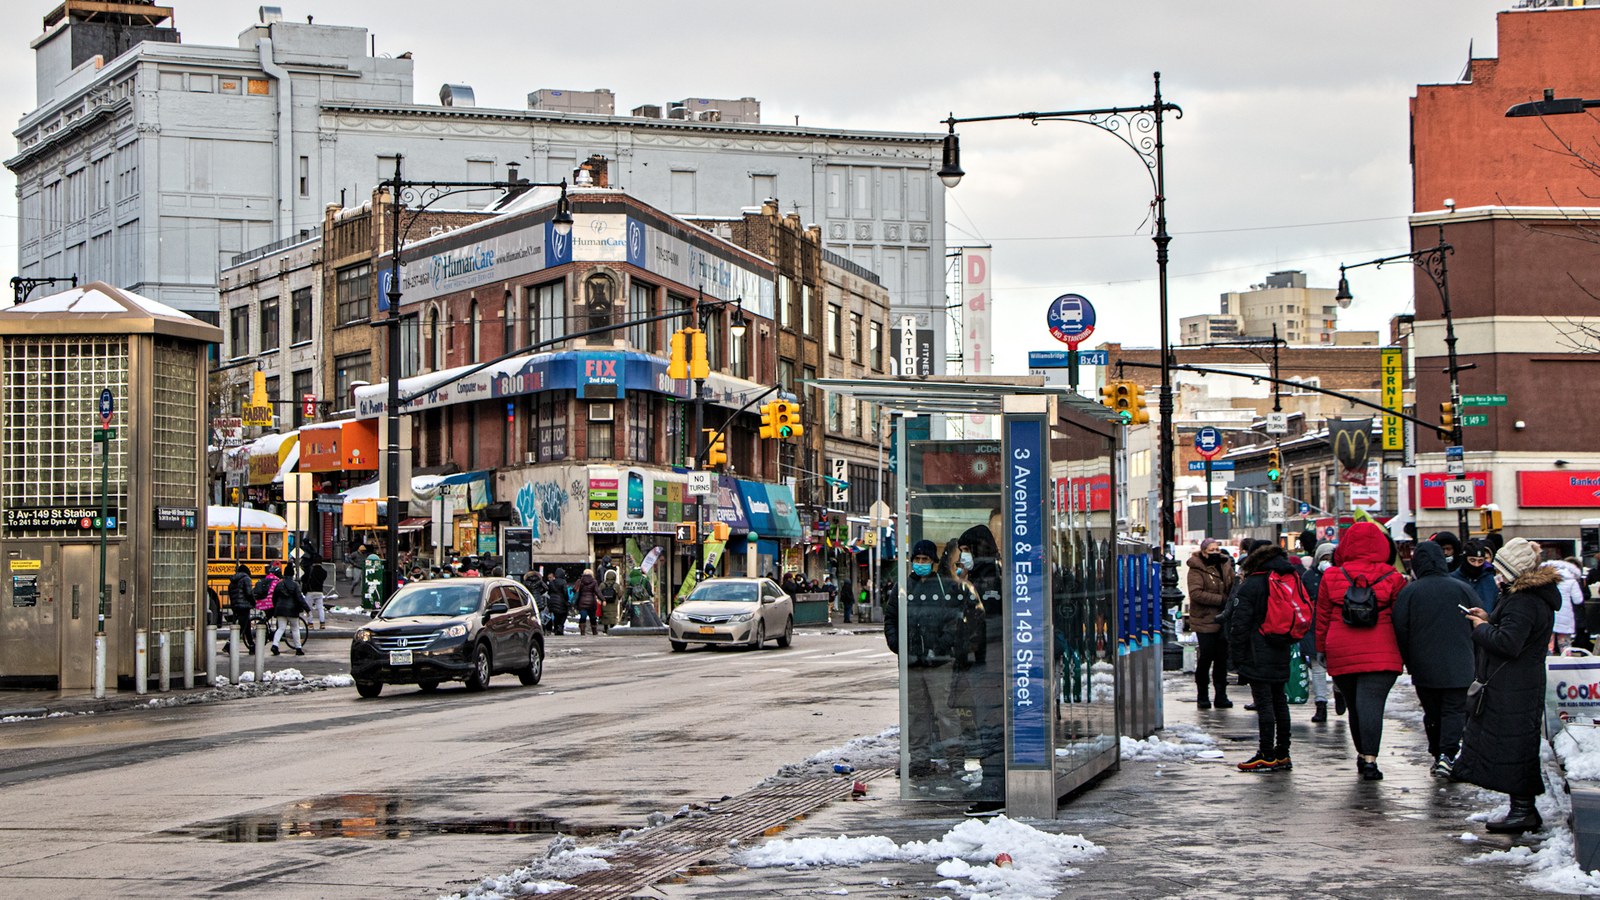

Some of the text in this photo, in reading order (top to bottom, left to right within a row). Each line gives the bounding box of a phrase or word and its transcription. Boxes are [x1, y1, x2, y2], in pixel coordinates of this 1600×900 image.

[572, 237, 627, 246] HumanCare
[443, 247, 494, 280] HumanCare
[1052, 329, 1092, 342] NO STANDING
[904, 318, 914, 375] TATTOO
[1080, 353, 1104, 364] Bx41
[585, 360, 616, 377] FIX
[456, 382, 477, 396] Computer
[243, 406, 272, 422] FABRIC
[1464, 416, 1468, 426] E
[1470, 416, 1480, 424] 149
[1423, 479, 1442, 488] Bank
[1570, 477, 1592, 486] Bank
[1453, 484, 1466, 493] NO
[1272, 497, 1280, 506] NO
[8, 508, 98, 519] 3 Av-149 St Station
[50, 518, 66, 527] Dyre
[1014, 448, 1034, 706] 3 Avenue & East 149 Street
